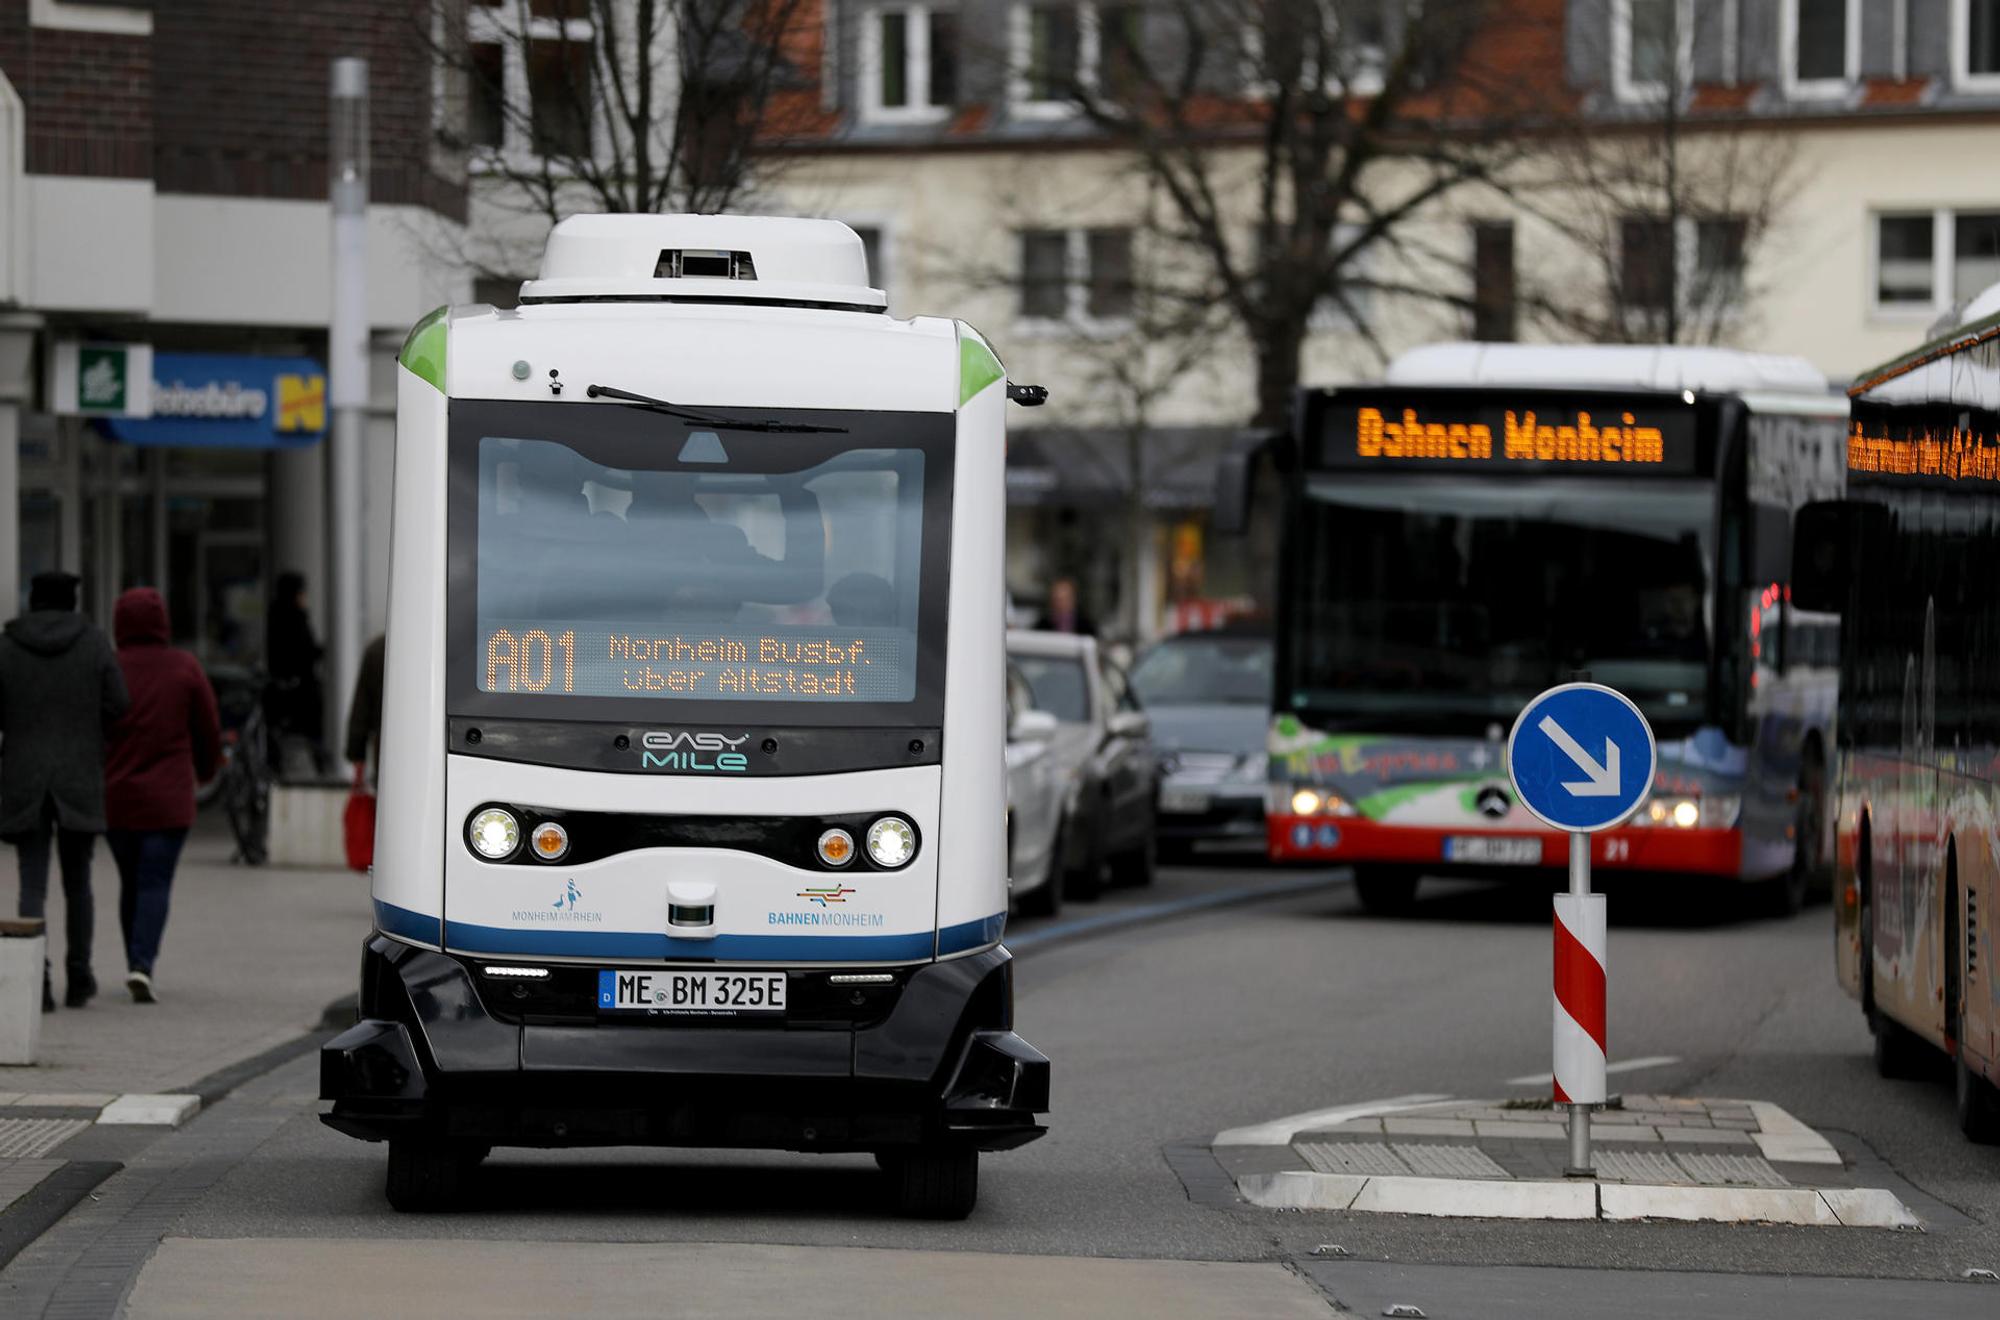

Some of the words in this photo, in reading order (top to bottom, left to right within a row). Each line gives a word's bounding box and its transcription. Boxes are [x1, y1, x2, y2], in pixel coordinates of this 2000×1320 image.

[1504, 410, 1664, 463] Monheim
[487, 629, 575, 693] A01
[608, 635, 747, 663] Monheim
[760, 637, 873, 665] Busbf.
[623, 667, 705, 692] über
[718, 668, 857, 695] Altstadt
[618, 975, 652, 1004] ME
[672, 976, 707, 1005] BM
[714, 977, 783, 1006] 325E
